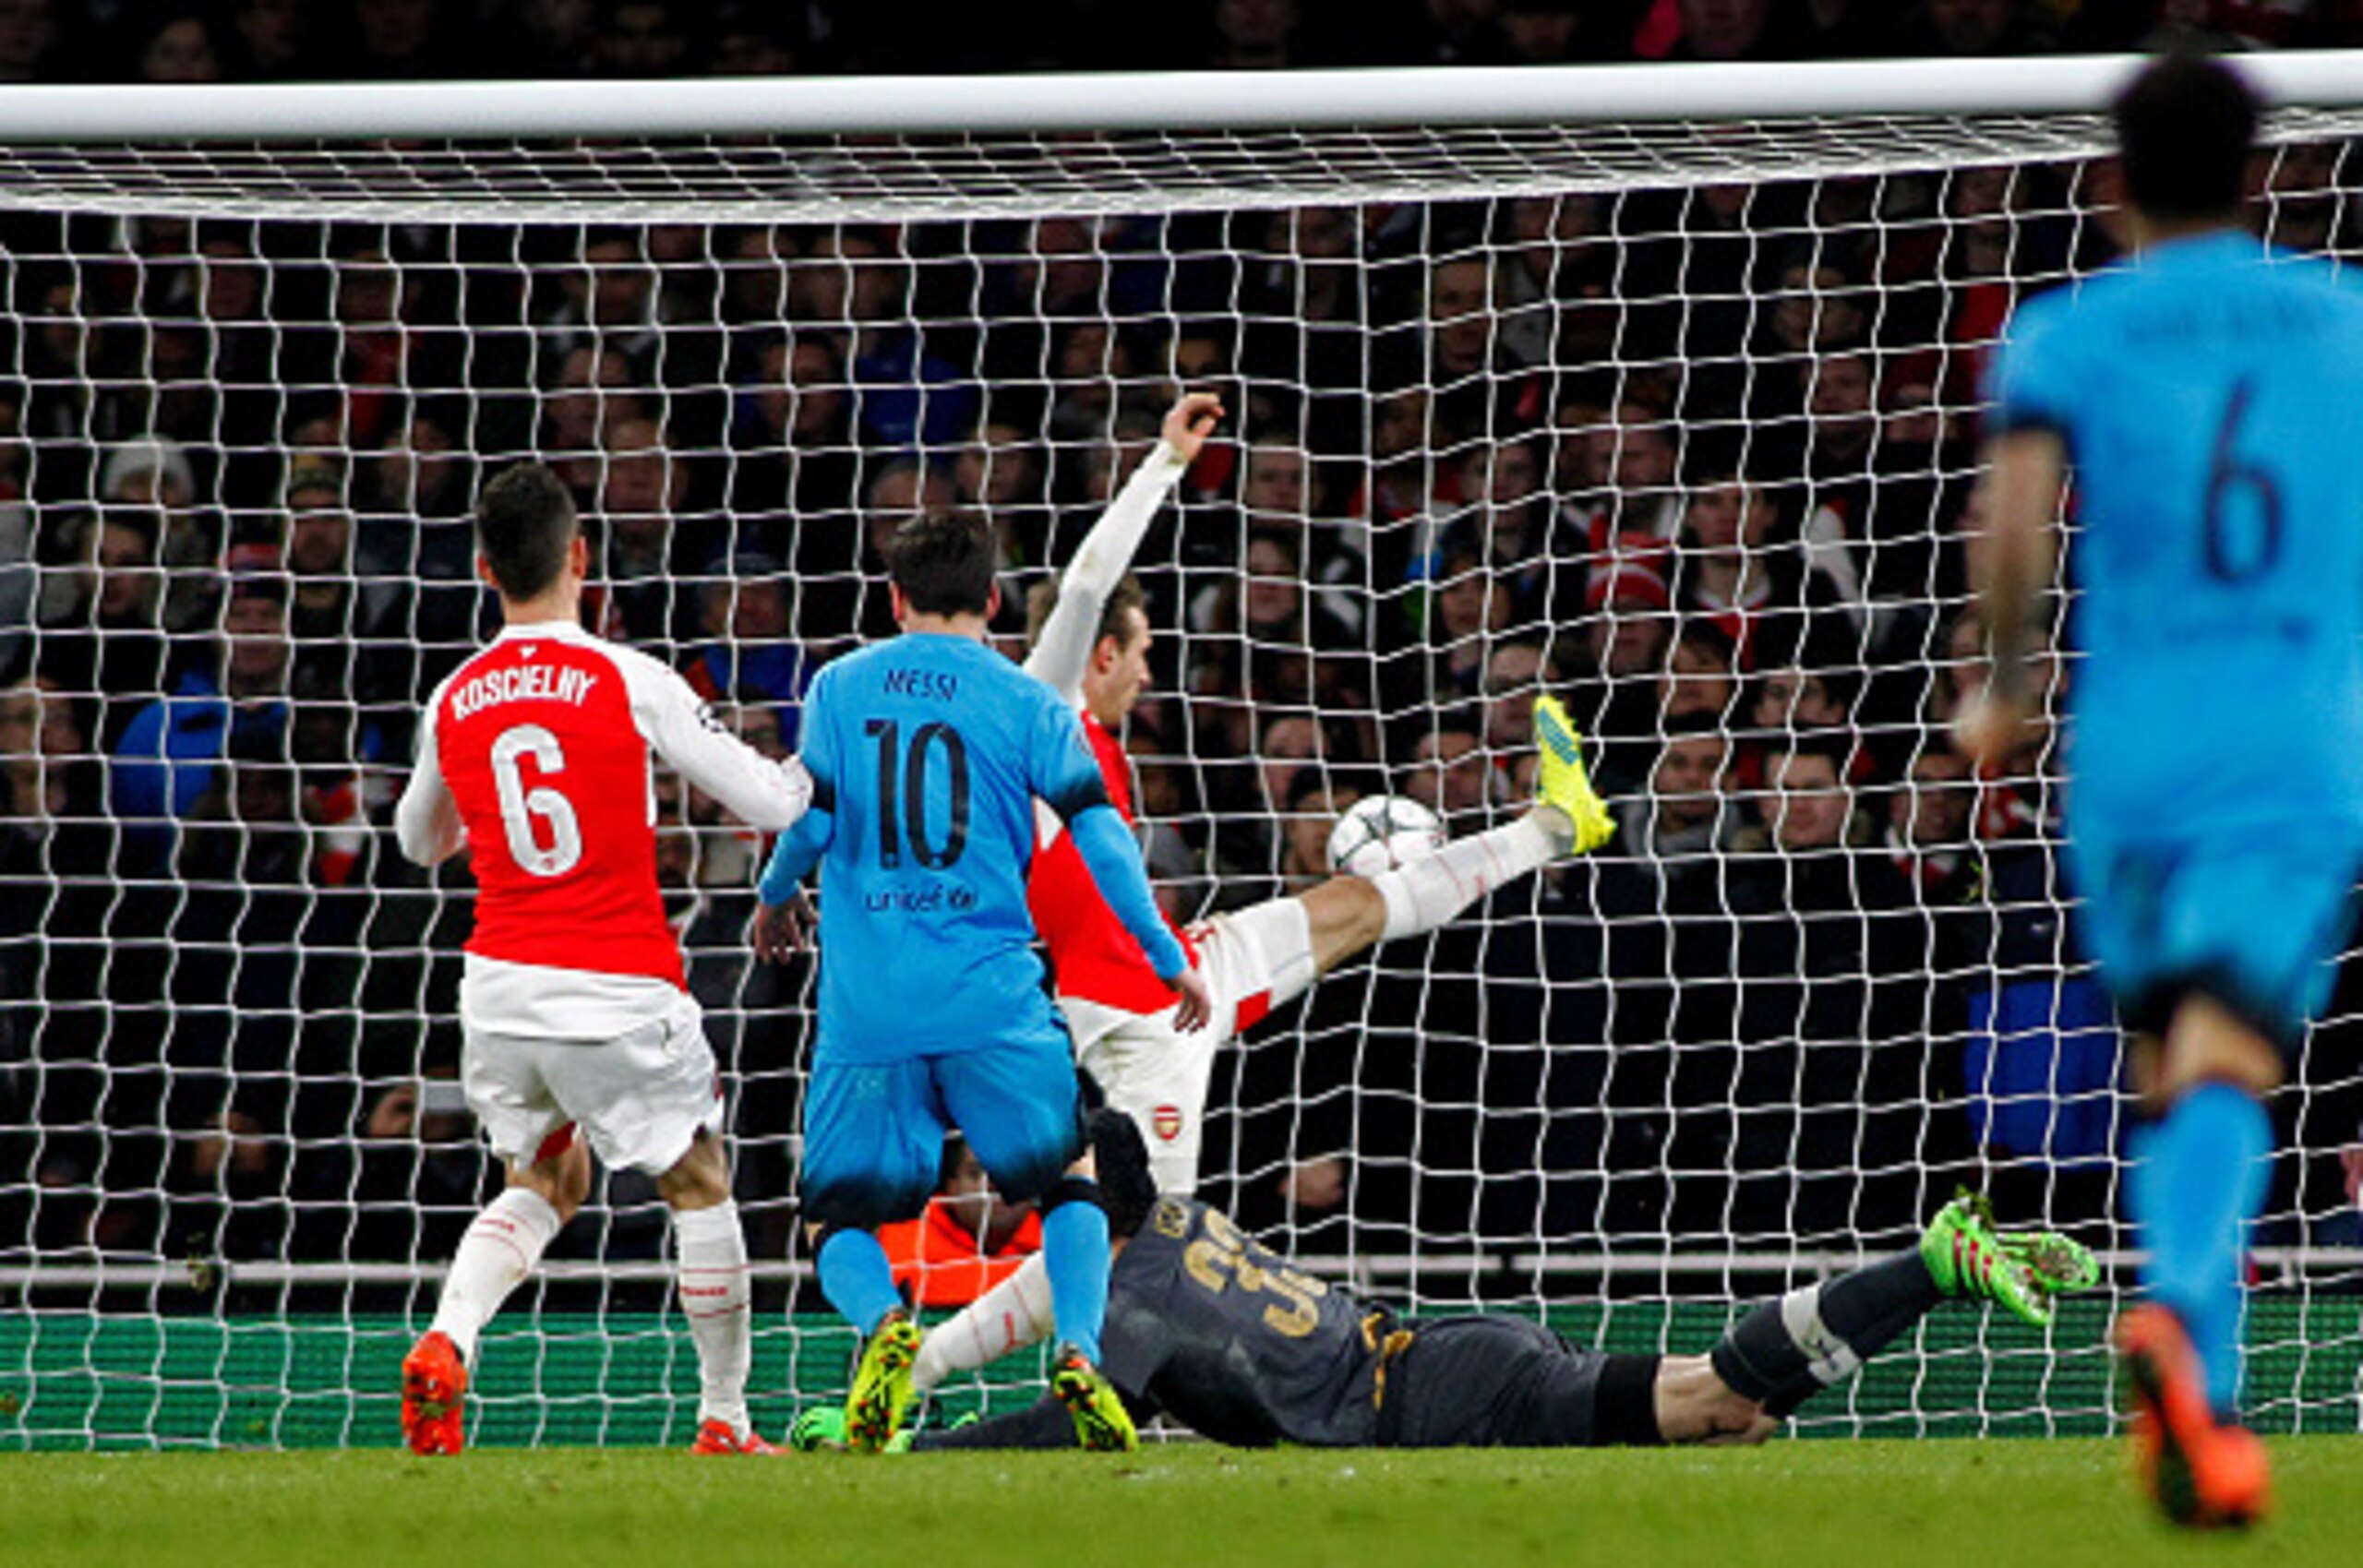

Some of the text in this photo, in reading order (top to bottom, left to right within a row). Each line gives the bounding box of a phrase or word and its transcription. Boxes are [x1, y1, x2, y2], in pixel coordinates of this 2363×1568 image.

[2201, 369, 2285, 586] 6
[450, 664, 597, 721] KOSCIELNY
[883, 668, 958, 701] MESSI
[490, 723, 583, 877] 6
[865, 717, 969, 870] 10
